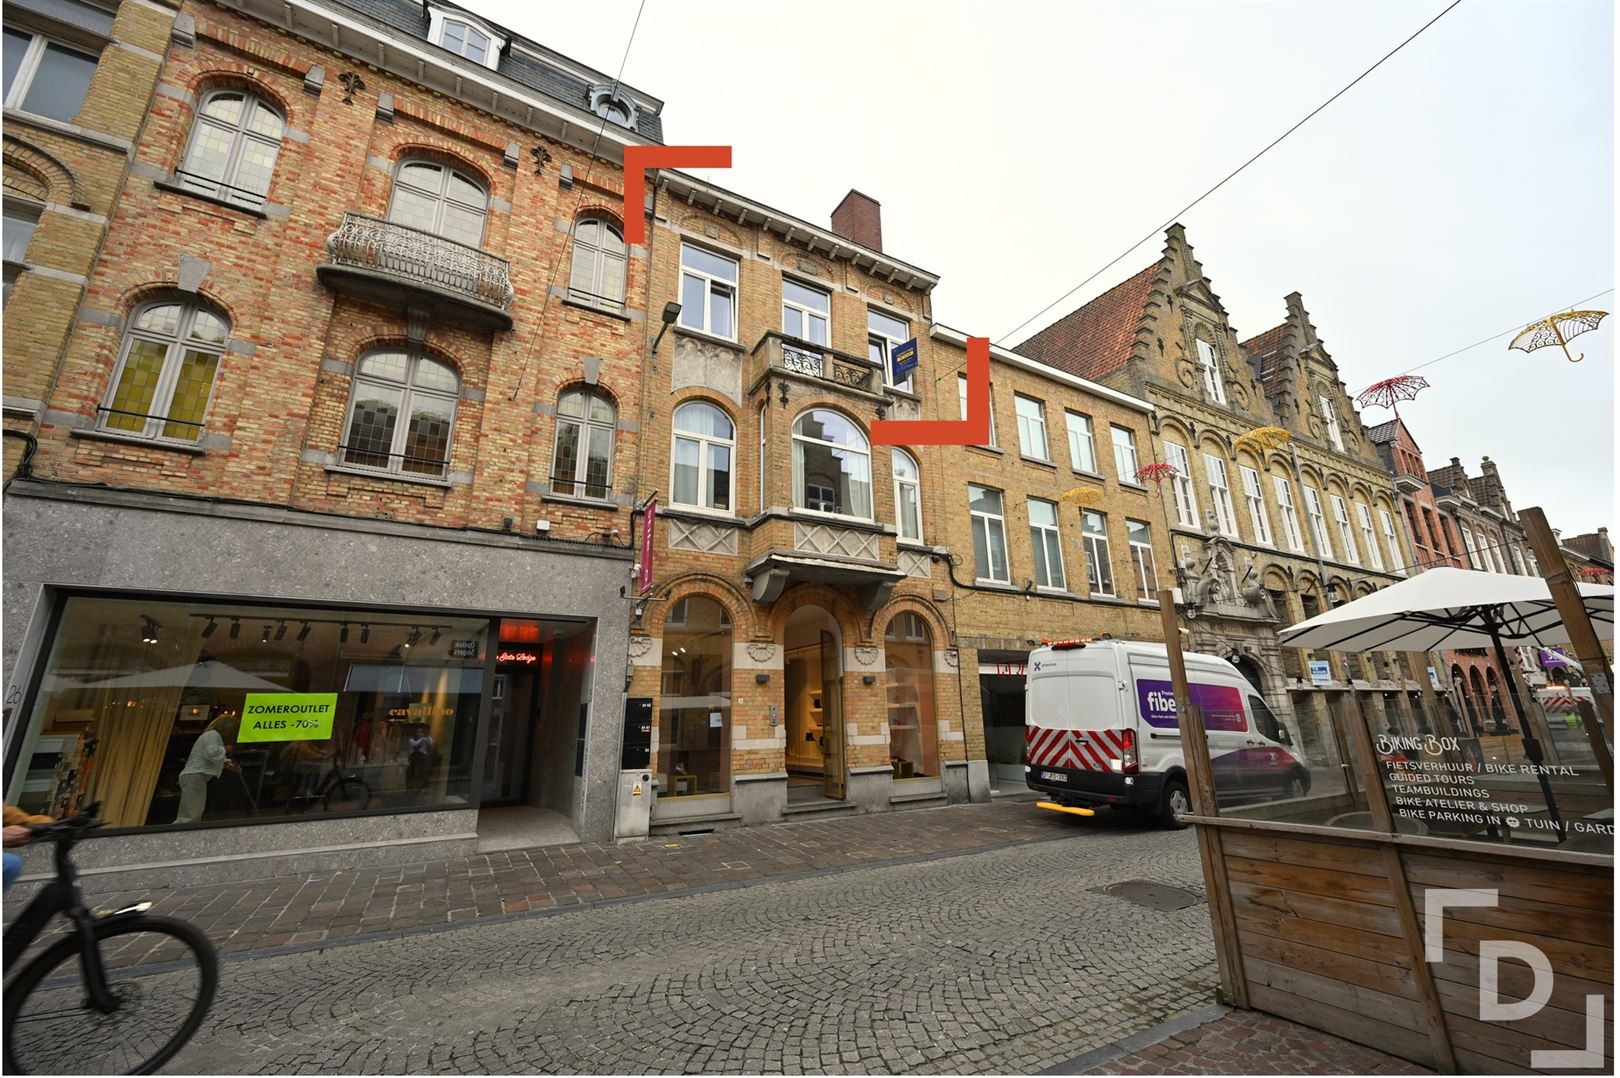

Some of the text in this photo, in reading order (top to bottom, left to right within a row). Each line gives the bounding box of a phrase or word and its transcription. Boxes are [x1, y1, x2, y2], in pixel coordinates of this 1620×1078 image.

[6, 685, 22, 704] 26
[248, 704, 330, 714] ZOMEROUTLET
[253, 719, 319, 730] ALLES -70%
[1386, 761, 1474, 773] FIETSVERHUUR
[1485, 763, 1517, 774] BIKE
[1520, 764, 1580, 776] RENTAL
[1389, 772, 1475, 785] GUIDED TOURS
[1392, 784, 1490, 799] TEAMBUILDINGS
[1395, 796, 1528, 814] BIKE ATELIER & SHOP
[1399, 808, 1426, 819] BIKE
[1428, 810, 1483, 824] PARKING
[1486, 815, 1501, 825] IN
[1524, 818, 1561, 831] TUIN
